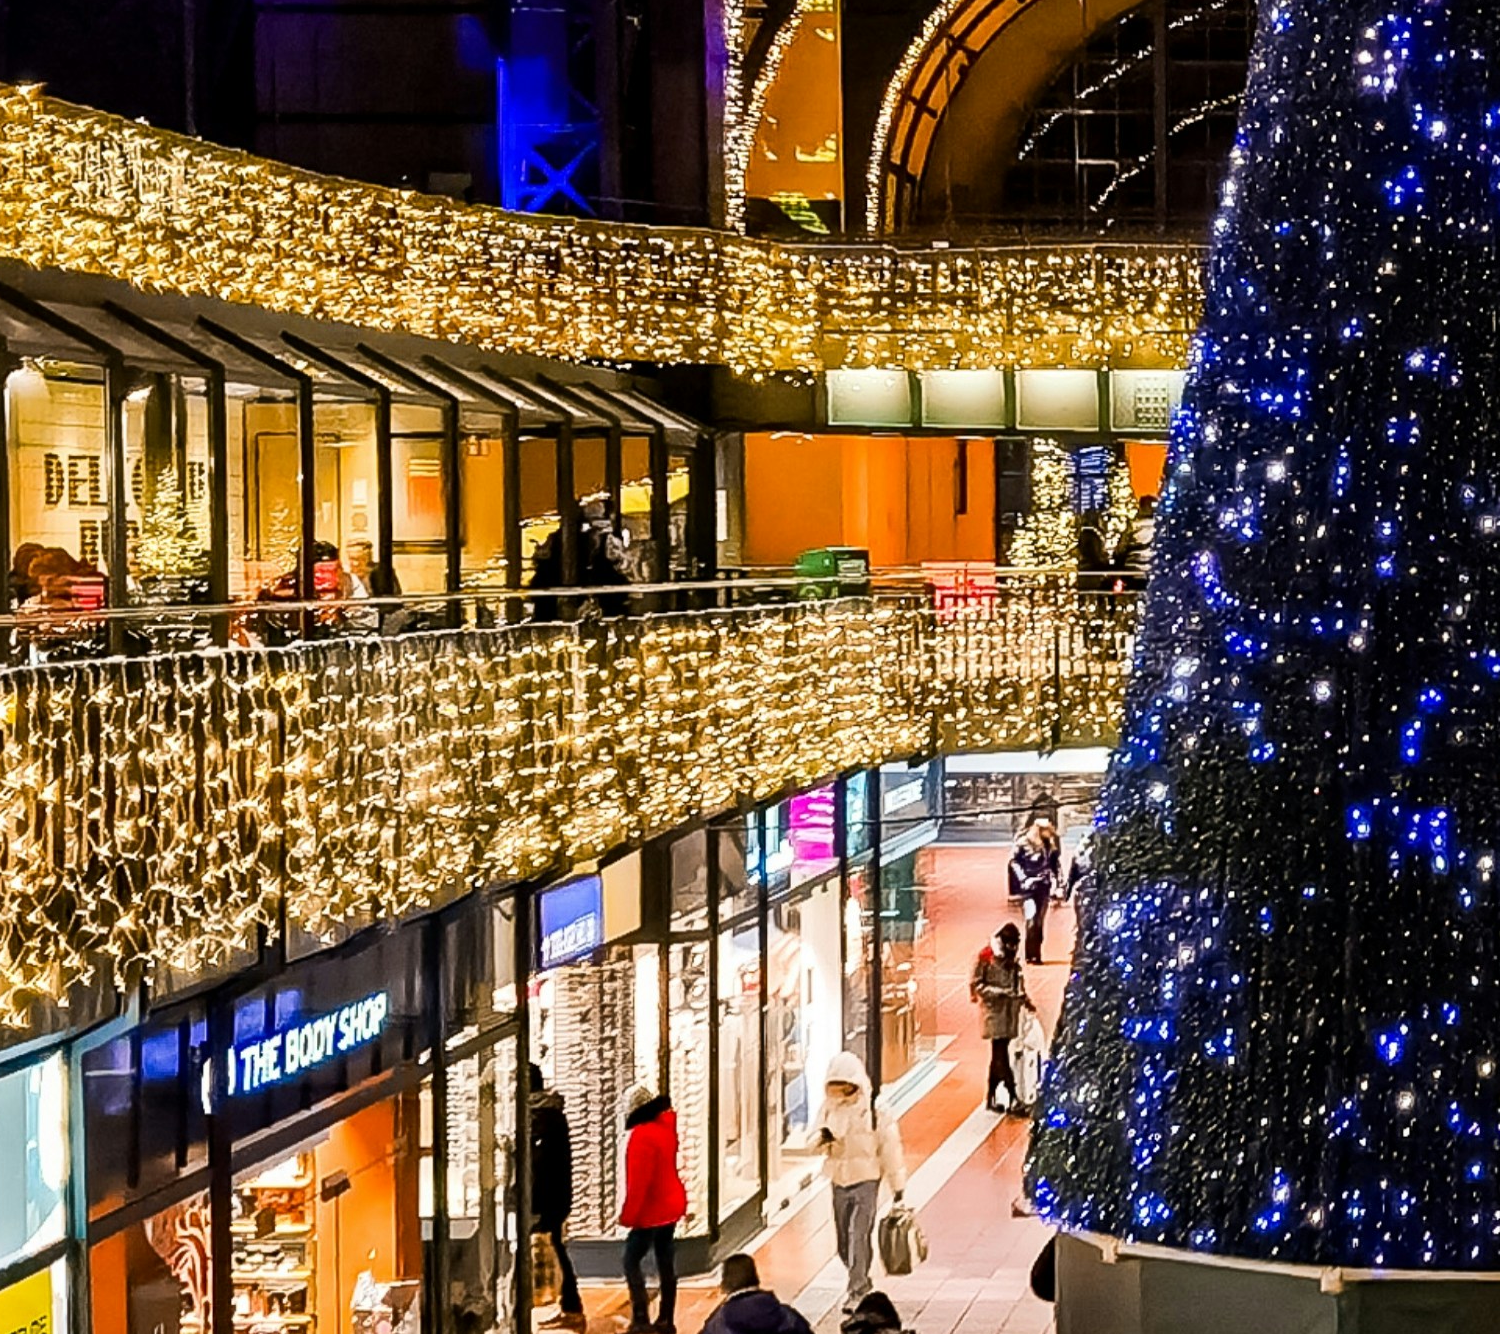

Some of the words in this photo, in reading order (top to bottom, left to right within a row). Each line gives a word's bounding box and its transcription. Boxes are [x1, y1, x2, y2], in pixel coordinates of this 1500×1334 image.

[240, 1033, 282, 1091] THE
[285, 1010, 339, 1074] BODY
[337, 992, 388, 1052] SHOP
